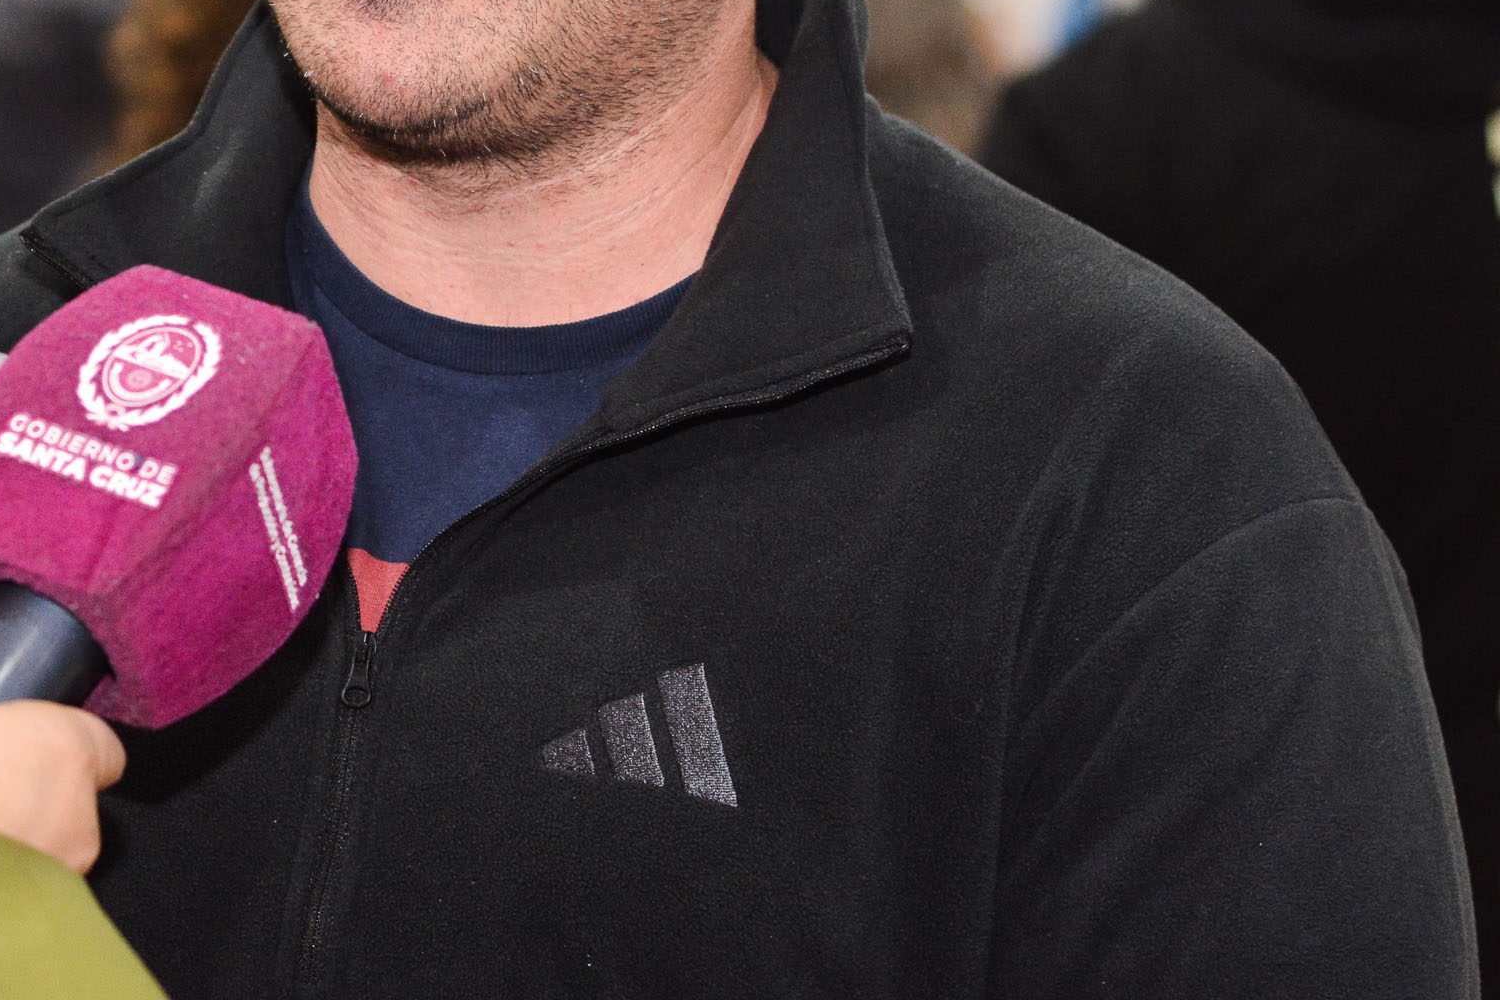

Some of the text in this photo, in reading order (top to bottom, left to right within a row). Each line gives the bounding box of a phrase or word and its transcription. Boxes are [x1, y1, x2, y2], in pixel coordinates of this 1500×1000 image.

[9, 413, 178, 486] GOBIERNO DE
[89, 465, 168, 508] CRUZ
